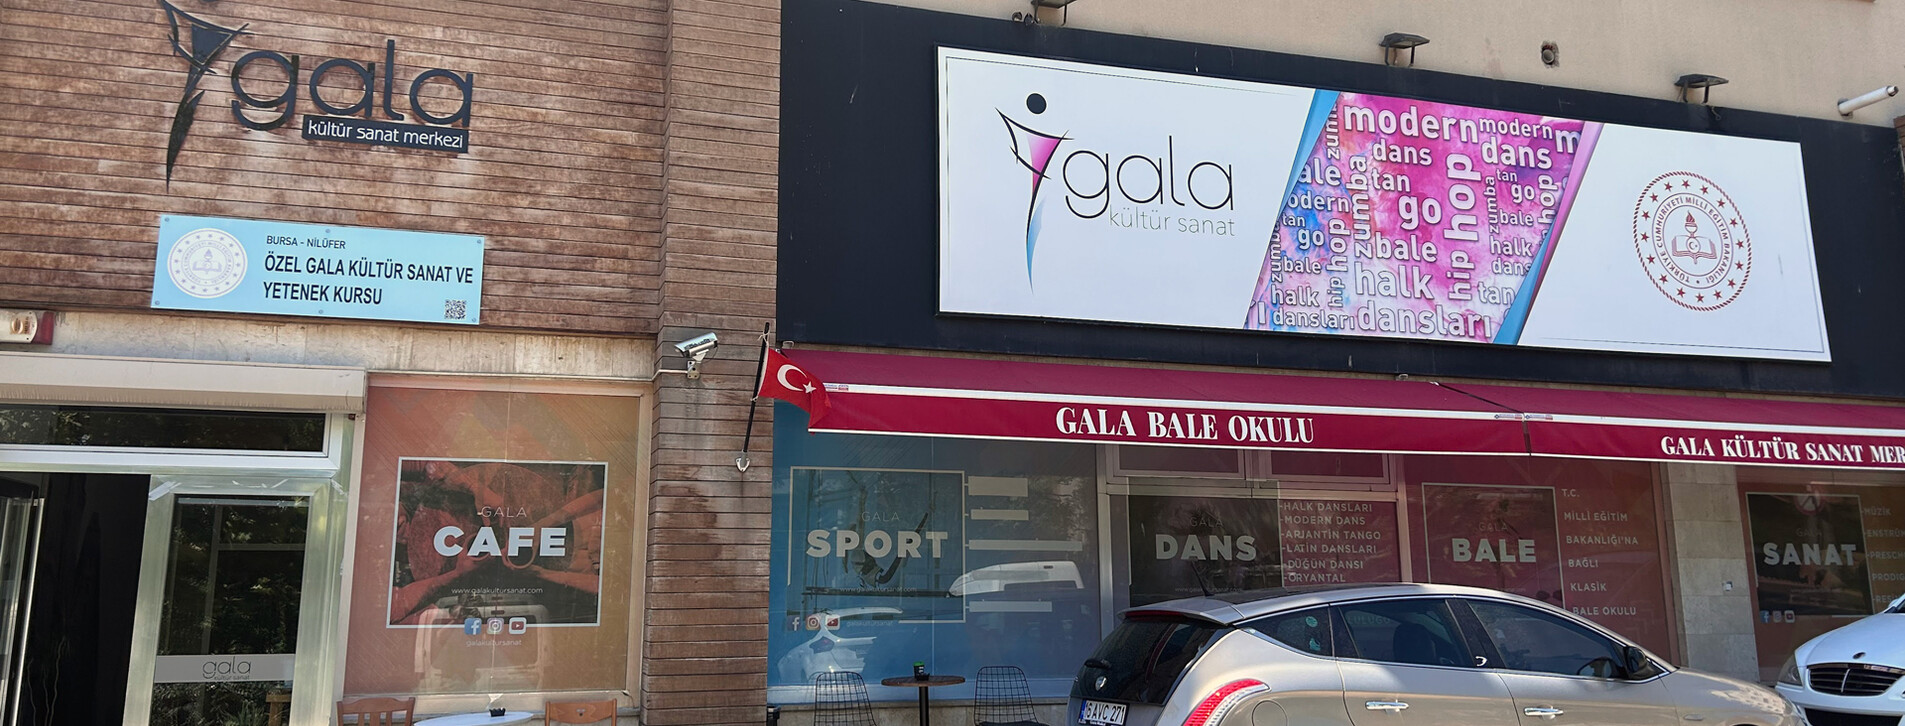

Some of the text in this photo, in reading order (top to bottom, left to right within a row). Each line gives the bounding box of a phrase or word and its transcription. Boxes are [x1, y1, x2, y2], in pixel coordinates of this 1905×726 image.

[231, 39, 473, 131] gala
[308, 120, 464, 149] kültür sanat merkezi
[1343, 105, 1479, 144] modern
[1479, 117, 1553, 140] modern
[1372, 137, 1433, 166] dans
[1481, 136, 1553, 170] dans
[1062, 135, 1234, 219] gala
[1371, 168, 1411, 193] tan
[1496, 168, 1518, 182] tan
[1483, 175, 1500, 234] zumba
[1511, 183, 1536, 204] go
[1538, 174, 1559, 225] hop
[1346, 155, 1373, 259] zumba
[1397, 194, 1442, 231] go
[1500, 208, 1534, 227] bale
[1109, 205, 1236, 237] kültür sanat
[1282, 213, 1306, 228] tan
[1444, 153, 1482, 301] hip hop
[266, 235, 298, 247] BURSA
[307, 237, 346, 250] NİLÜFER
[1297, 229, 1325, 251] go
[1374, 231, 1438, 263] bale
[1490, 235, 1533, 257] halk
[264, 251, 473, 284] ÖZEL GALA KÜLTÜR SANAT VE
[1283, 256, 1322, 275] bale
[1326, 218, 1350, 309] hip hop
[1354, 261, 1434, 300] halk
[263, 281, 382, 305] YETENEK KURSU
[1271, 284, 1321, 308] halk
[1478, 281, 1516, 305] tan
[1272, 307, 1355, 330] dansları
[1357, 300, 1492, 338] dansları
[1055, 407, 1314, 443] GALA BALE OKULU
[1661, 436, 1715, 457] GALA
[1720, 434, 1800, 460] KÜLTÜR
[1805, 442, 1864, 462] SANAT
[1561, 489, 1580, 497] T.C.
[481, 506, 527, 518] GALA
[861, 511, 900, 522] GALA
[1317, 503, 1373, 512] DANSLARI
[1564, 510, 1628, 522] MİLLİ EĞİTİM
[1189, 517, 1225, 528] GALA
[1335, 516, 1366, 525] DANS
[1478, 521, 1509, 532] GALA
[433, 525, 567, 557] CAFE
[806, 529, 948, 559] SPORT
[1343, 530, 1382, 540] TANGO
[1566, 533, 1639, 545] BAKANLIĞI'NA
[1155, 534, 1257, 561] DANS
[1321, 543, 1377, 554] DANSLARI
[1451, 538, 1537, 563] BALE
[1763, 542, 1857, 566] SANAT
[1330, 560, 1364, 569] DANSI
[1568, 557, 1599, 568] BAĞLI
[1570, 581, 1607, 592] KLASİK
[1572, 606, 1637, 616] BALE OKULU
[202, 656, 251, 679] gala
[1092, 703, 1109, 721] AVC
[1110, 706, 1125, 722] 271
